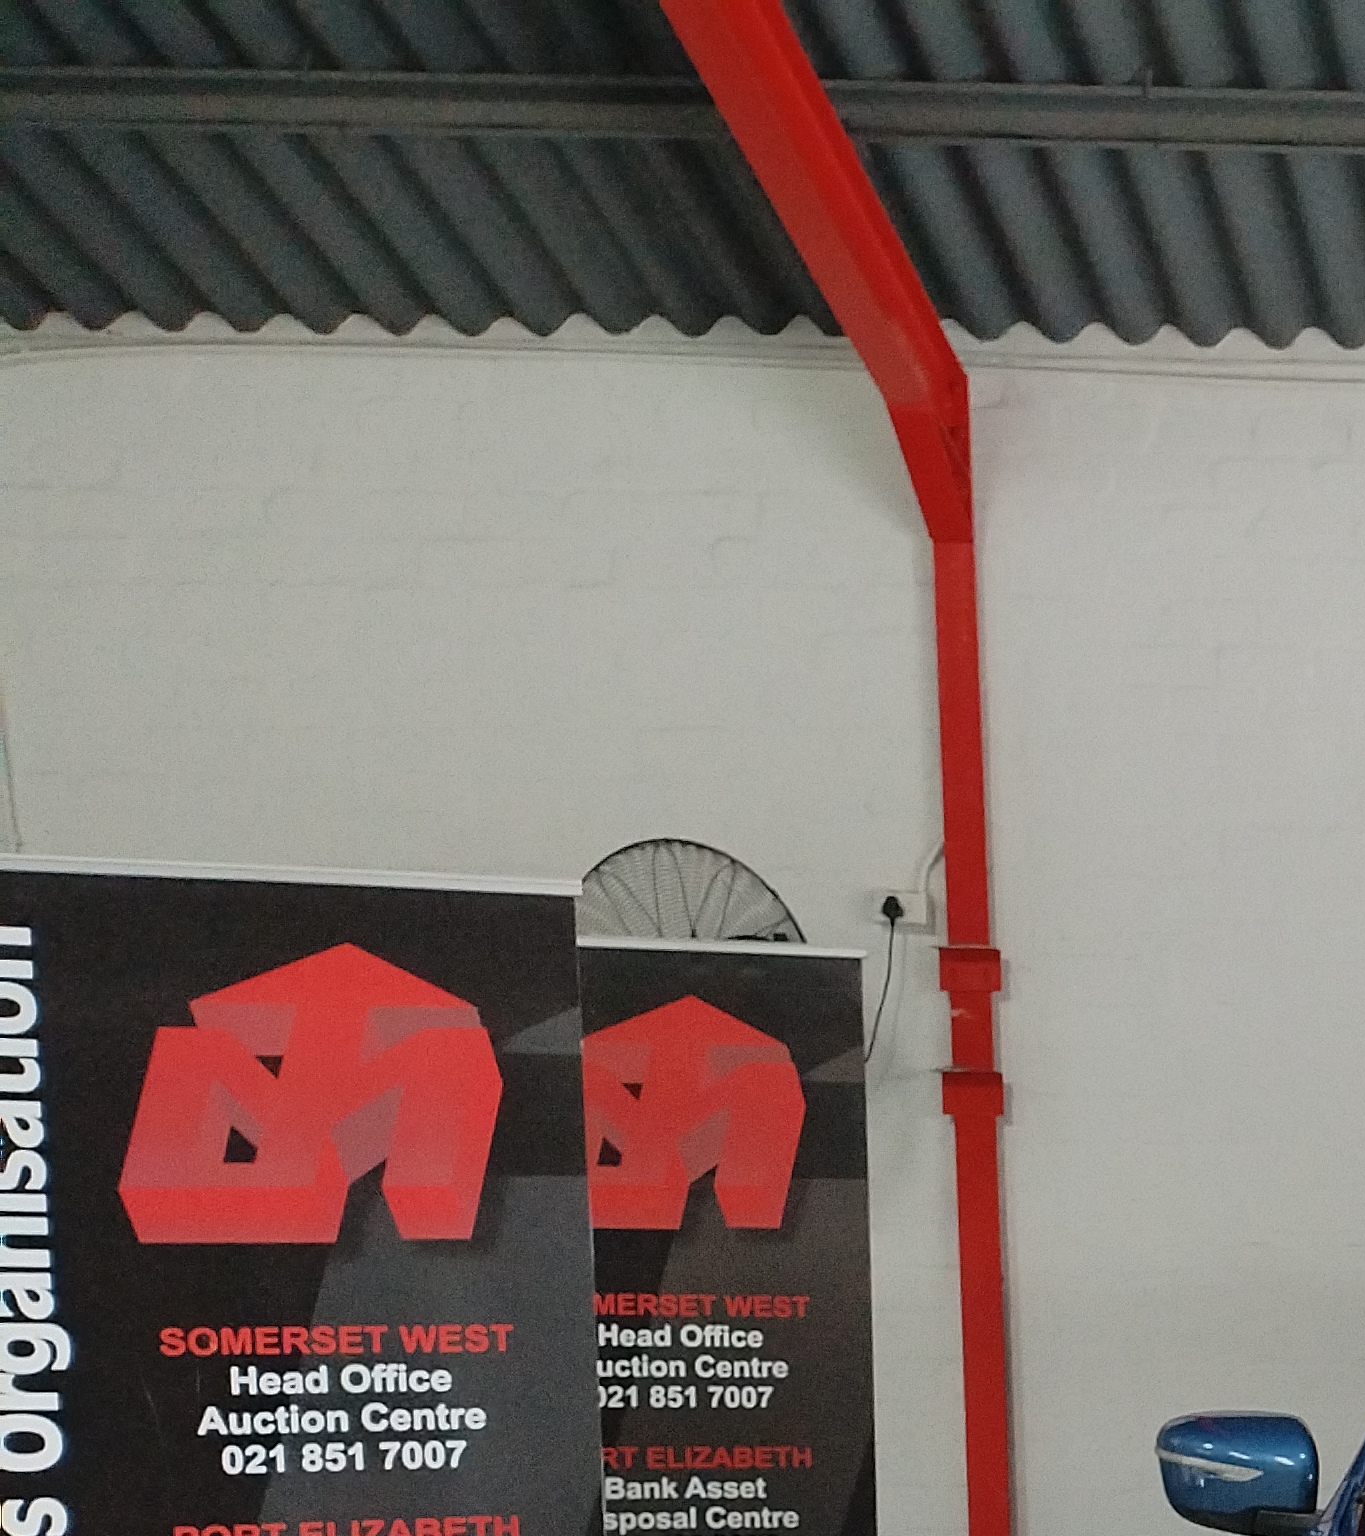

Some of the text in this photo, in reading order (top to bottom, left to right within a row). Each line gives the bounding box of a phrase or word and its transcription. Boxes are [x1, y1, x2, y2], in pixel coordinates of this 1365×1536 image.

[593, 1293, 810, 1318] MERSET WEST
[158, 1323, 514, 1357] SOMERSET WEST
[598, 1323, 763, 1347] Head Office
[694, 1354, 788, 1378] Centre
[230, 1363, 453, 1396] Head Office
[650, 1385, 774, 1408] 851 7007
[198, 1401, 487, 1436] Auction Centre
[222, 1440, 467, 1475] 021 851 7007
[647, 1446, 813, 1469] ELIZABETH
[604, 1476, 767, 1500] Bank Asset
[705, 1506, 799, 1529] Centre
